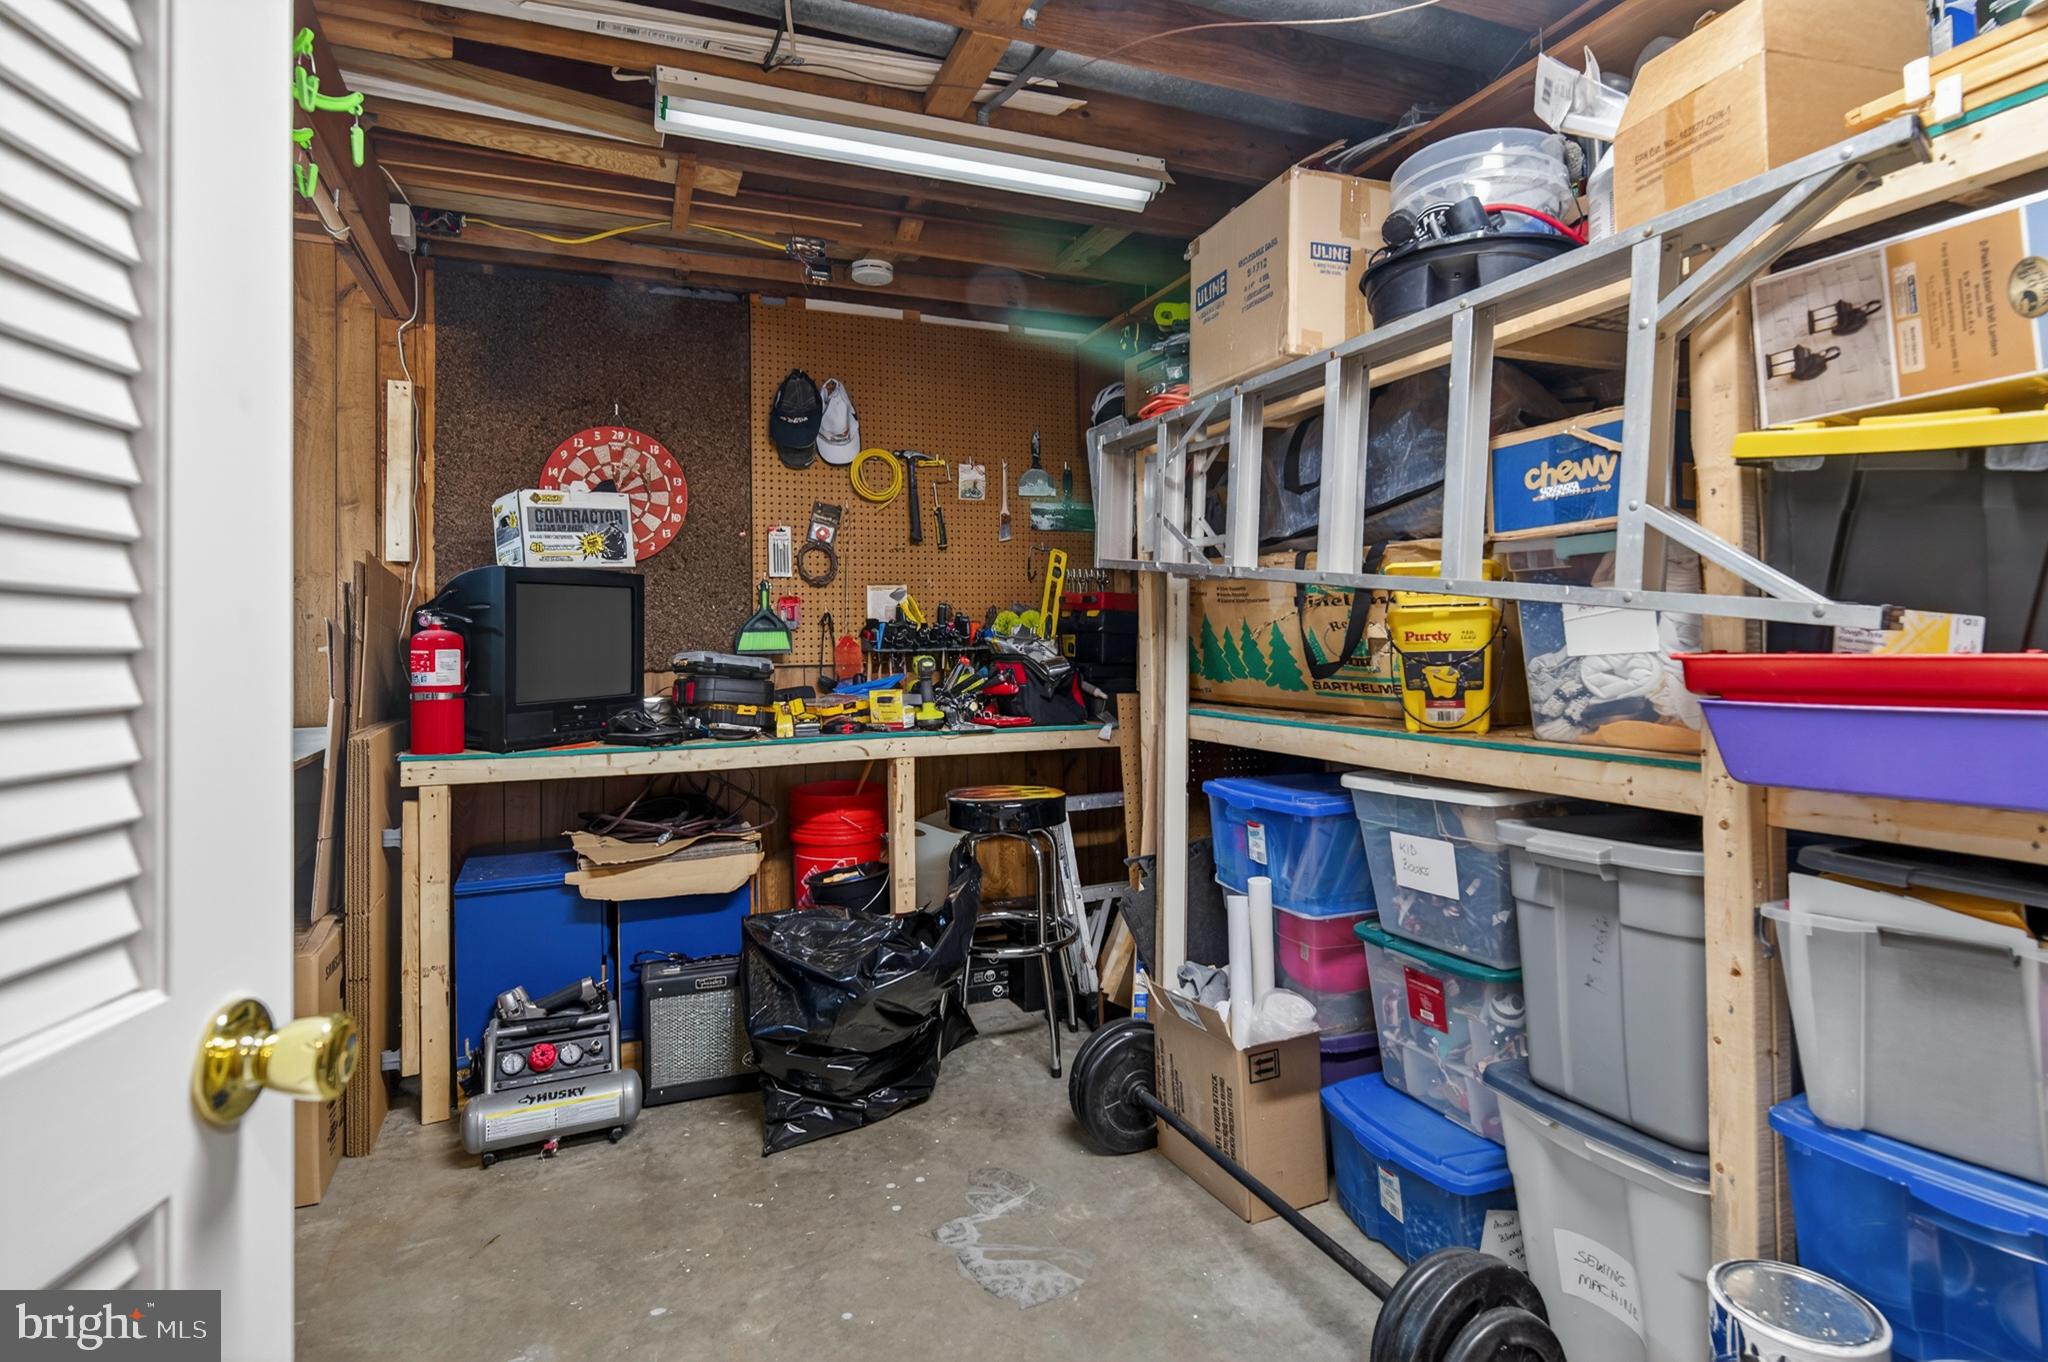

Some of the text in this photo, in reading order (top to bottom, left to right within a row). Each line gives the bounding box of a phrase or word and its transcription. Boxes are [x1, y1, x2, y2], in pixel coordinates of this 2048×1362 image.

[1312, 244, 1350, 261] ULINE
[1197, 274, 1226, 307] ULINE
[594, 431, 601, 441] 5
[1524, 453, 1618, 490] chewy
[675, 495, 683, 504] 6
[534, 507, 623, 525] CONTRACTOR
[1404, 630, 1452, 643] Purdy
[1399, 842, 1417, 856] KID
[537, 1086, 587, 1104] HUSKY
[1573, 1250, 1627, 1288] SEWING
[1578, 1273, 1640, 1321] MACHINE
